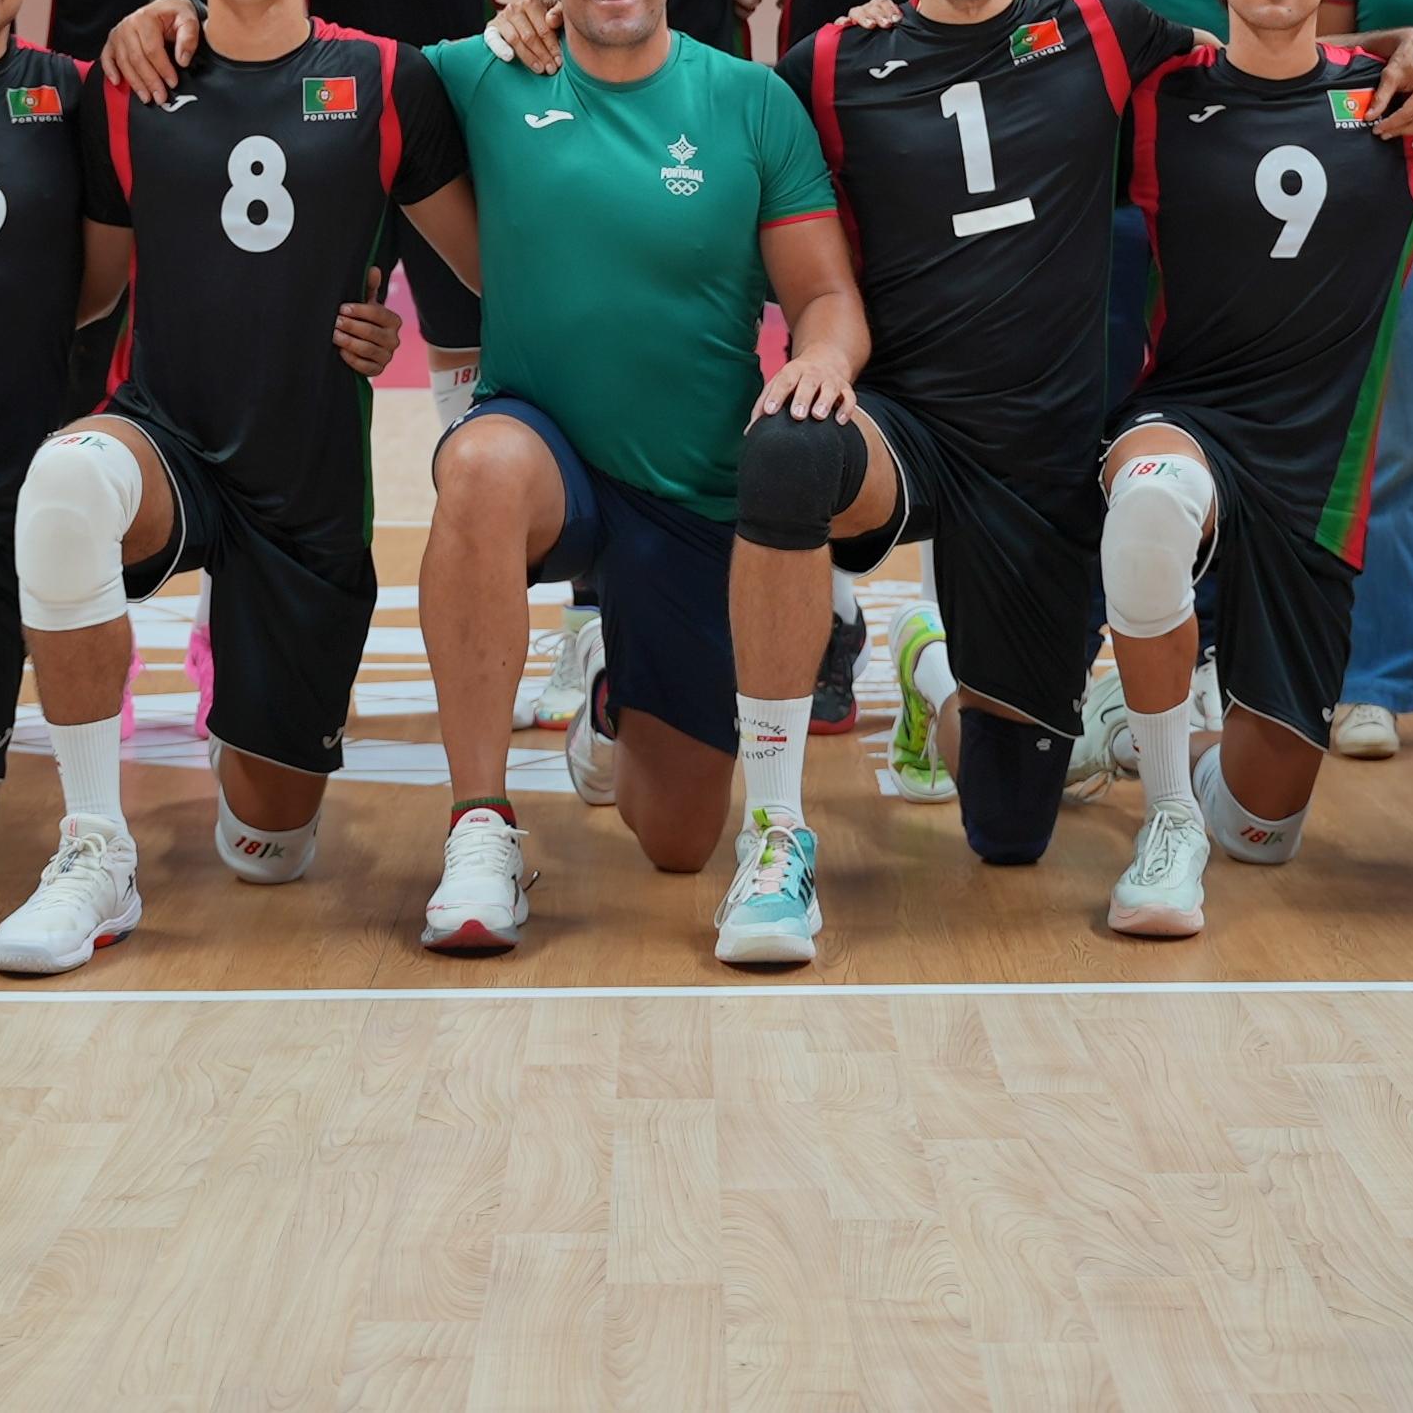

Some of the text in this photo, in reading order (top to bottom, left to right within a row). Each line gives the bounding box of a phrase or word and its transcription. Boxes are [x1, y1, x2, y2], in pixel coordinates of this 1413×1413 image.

[1013, 45, 1067, 66] PORTUGAL
[10, 114, 64, 124] PORTUGAL
[302, 112, 358, 123] PORTUGAL
[940, 81, 995, 194] 1
[660, 167, 706, 183] PORTUGAL
[220, 134, 295, 253] 8
[1254, 144, 1328, 259] 9
